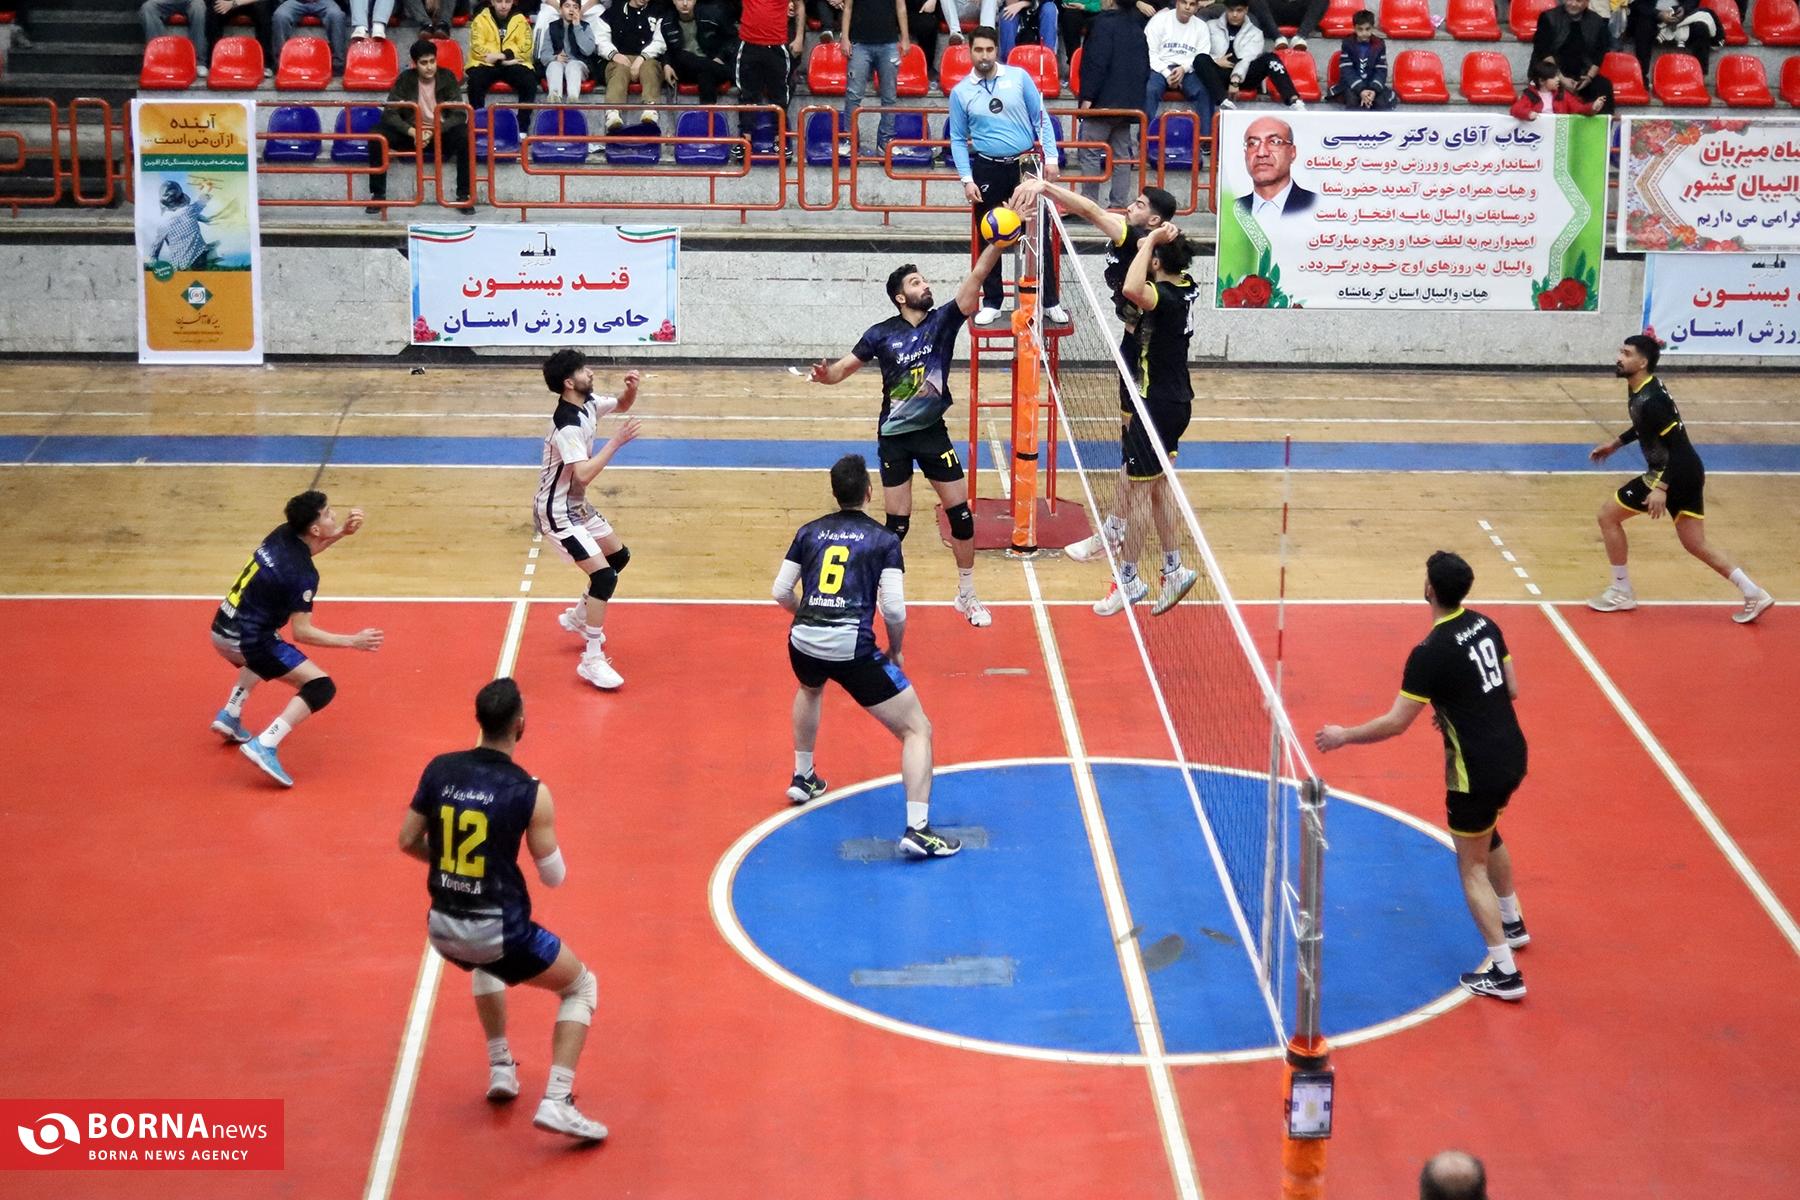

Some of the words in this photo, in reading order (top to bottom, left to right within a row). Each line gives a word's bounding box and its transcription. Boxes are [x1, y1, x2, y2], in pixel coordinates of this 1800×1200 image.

[170, 113, 216, 133] آینده
[154, 133, 187, 145] است
[187, 137, 208, 148] من
[1323, 129, 1393, 149] حبیبی
[1399, 126, 1439, 147] دکتر
[1444, 125, 1489, 148] آقای
[1495, 127, 1541, 147] جناب
[1703, 140, 1769, 164] میزبان
[1305, 156, 1358, 173] کرمانشاه
[1361, 158, 1398, 172] دوست
[1401, 157, 1439, 174] ورزش
[1442, 162, 1450, 174] و
[1452, 158, 1496, 173] مردمی
[1496, 158, 1541, 173] استاندار
[1322, 182, 1343, 196] شما
[1382, 181, 1419, 196] آمدید
[1422, 184, 1455, 200] خوش
[1459, 183, 1492, 198] همراه
[1684, 172, 1737, 198] کشور
[1741, 174, 1800, 198] الیبال
[1529, 188, 1537, 200] و
[1315, 207, 1348, 220] ماست
[1351, 208, 1396, 224] افتخار
[1433, 208, 1472, 224] والیبال
[1697, 208, 1733, 228] داریم
[1736, 213, 1758, 228] می
[1308, 233, 1360, 250] مبارکتان
[1363, 236, 1395, 250] وجود
[1398, 238, 1406, 250] و
[1408, 234, 1431, 247] خدا
[1434, 234, 1463, 248] لطف
[1465, 236, 1479, 249] به
[1480, 234, 1535, 249] امیدواریم
[1363, 262, 1397, 275] خود
[1401, 260, 1424, 275] اوج
[1426, 260, 1472, 276] روزهای
[1474, 262, 1487, 275] به
[1493, 259, 1532, 275] والیبال
[462, 271, 563, 298] بیستون
[571, 266, 630, 290] قند
[1338, 287, 1386, 300] کرمانشاه
[1388, 288, 1419, 300] استان
[1421, 288, 1459, 300] والیبال
[1461, 289, 1489, 300] هیات
[1693, 283, 1790, 308] بیستون
[443, 308, 518, 334] استان
[524, 309, 587, 334] ورزش
[593, 308, 650, 334] حامی
[1671, 318, 1744, 343] استان
[1748, 320, 1800, 344] رزش
[818, 545, 850, 595] 6
[1468, 637, 1504, 694] 19
[439, 804, 488, 878] 12
